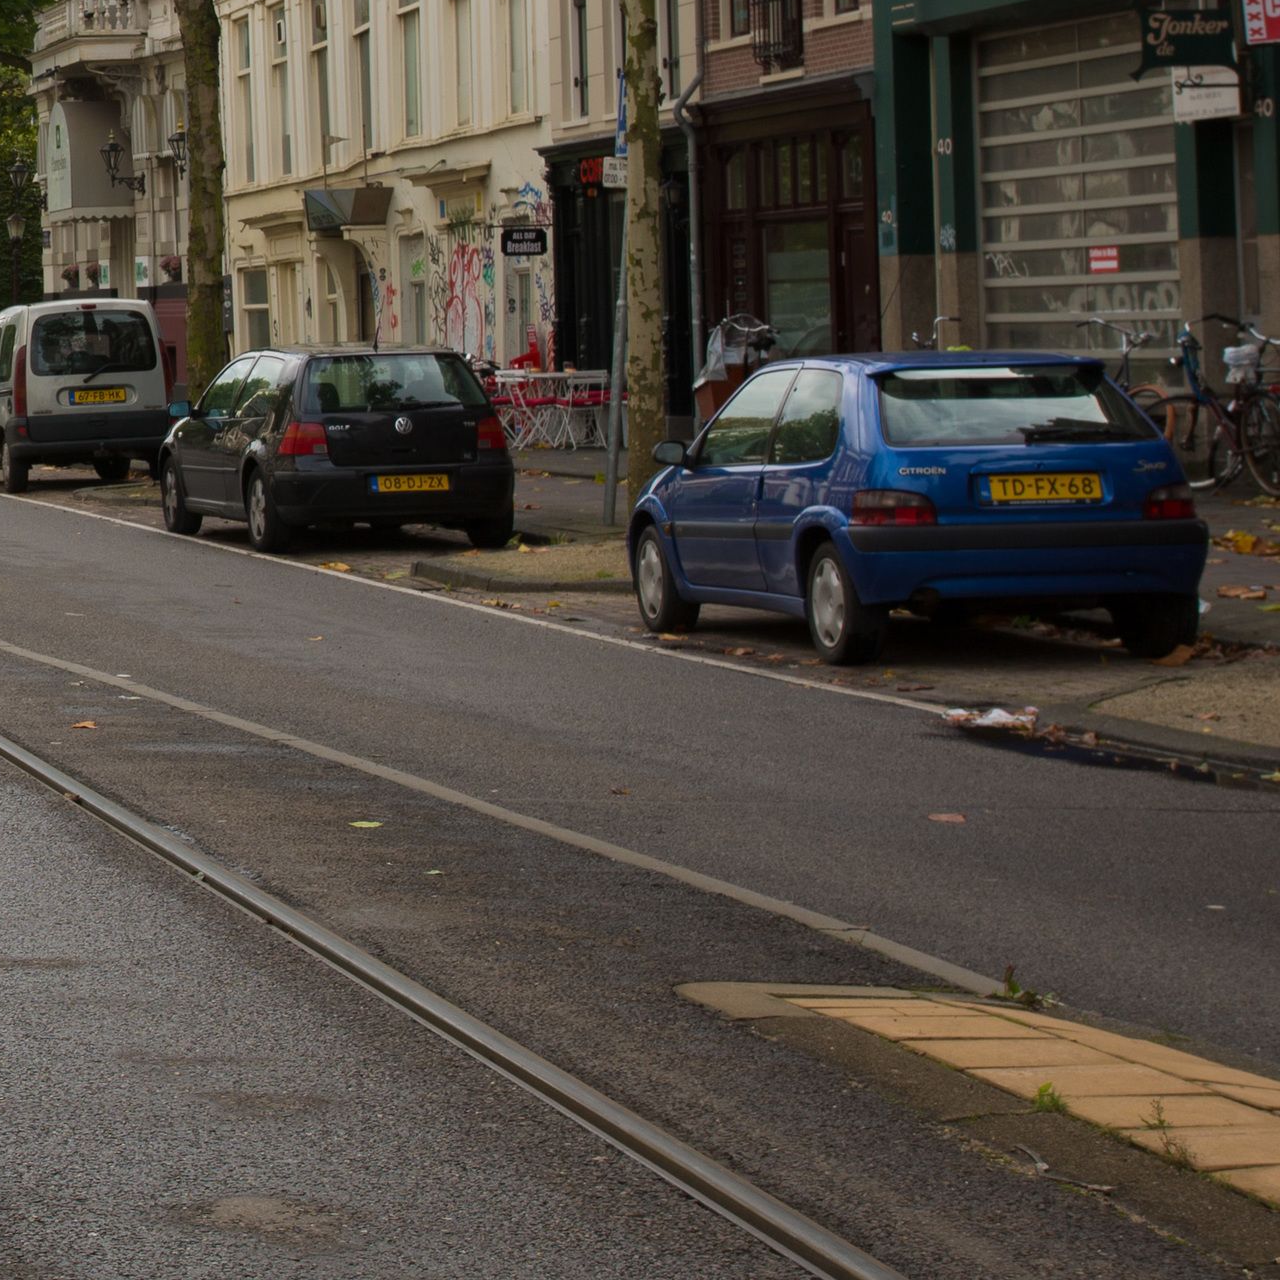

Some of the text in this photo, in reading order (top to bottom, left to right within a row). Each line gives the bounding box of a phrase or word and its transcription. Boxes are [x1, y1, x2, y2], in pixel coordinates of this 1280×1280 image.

[1146, 12, 1229, 46] Jonker
[1255, 98, 1274, 118] 40
[937, 138, 952, 155] 40
[881, 210, 893, 224] 40
[512, 231, 537, 240] ALL DAY
[506, 241, 542, 253] Breakfast
[78, 389, 123, 402] 67-FB-HK
[897, 466, 947, 476] CITROËN
[383, 476, 446, 489] 08-DJ-ZX
[999, 476, 1094, 497] TD-FX-68
